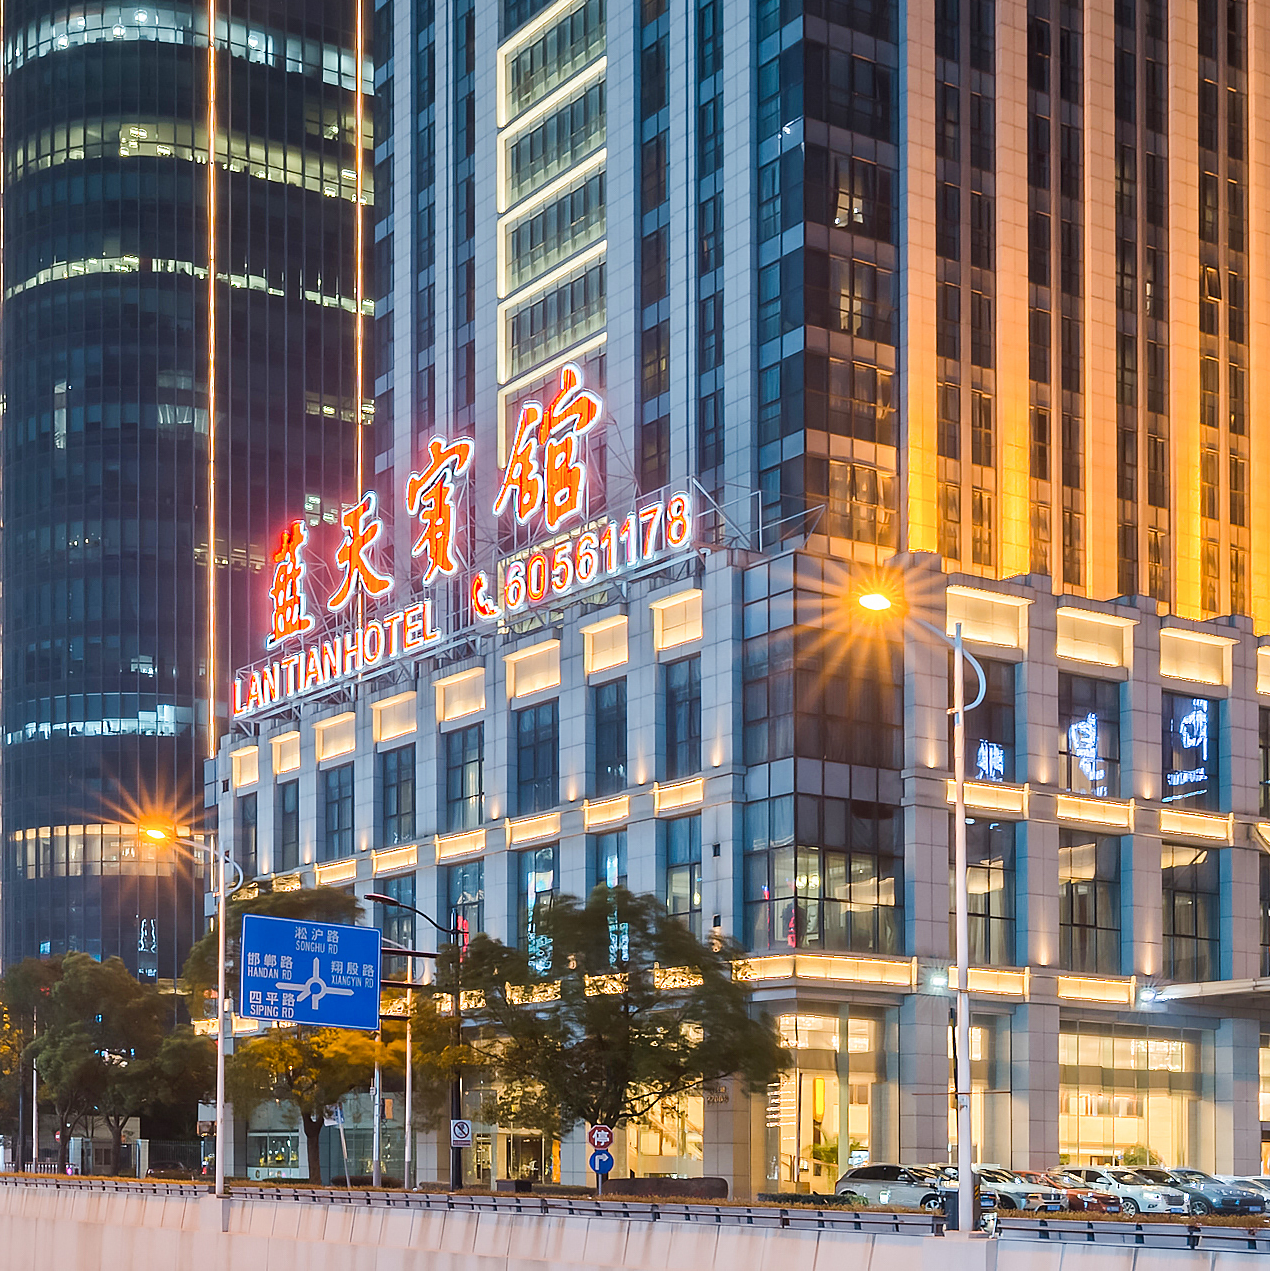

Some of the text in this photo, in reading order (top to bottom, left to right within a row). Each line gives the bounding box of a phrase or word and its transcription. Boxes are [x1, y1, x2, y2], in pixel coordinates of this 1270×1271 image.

[504, 490, 693, 611] 60561178
[295, 926, 340, 944] 淞沪路
[295, 940, 339, 955] SONGHU RD
[247, 952, 293, 970] 邯郸路
[331, 960, 374, 978] 翔殷路
[247, 966, 292, 980] HANDAN RD
[331, 974, 374, 988] XIANGYIN RD
[249, 990, 295, 1007] 四平路
[250, 1004, 294, 1019] SIPING RD
[592, 1129, 610, 1146] 停
